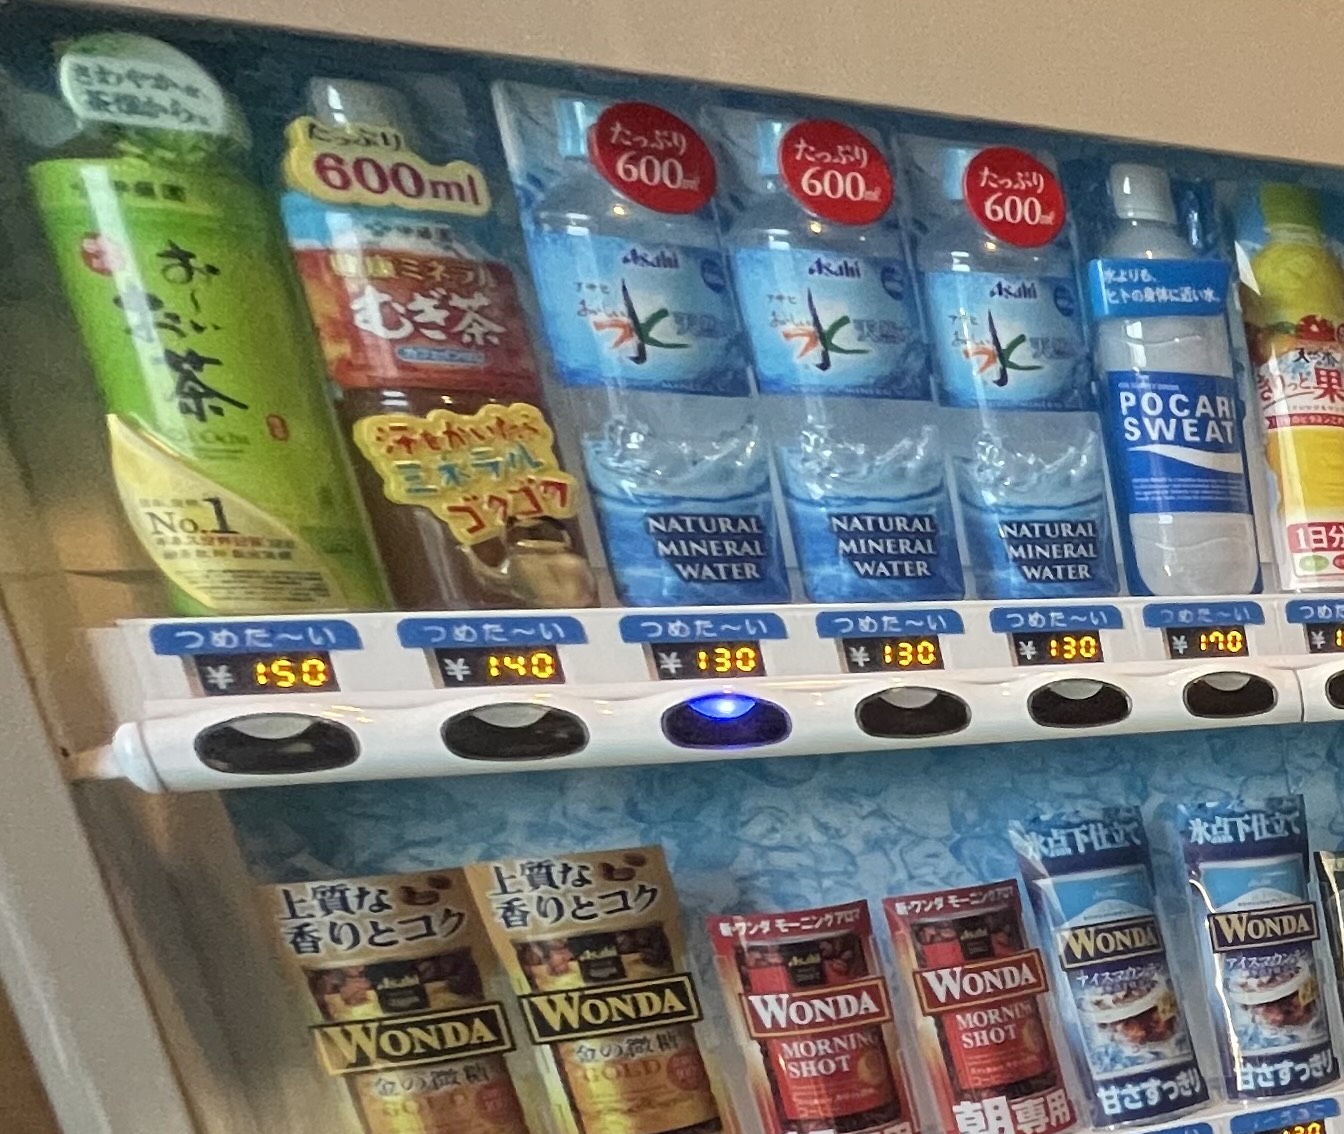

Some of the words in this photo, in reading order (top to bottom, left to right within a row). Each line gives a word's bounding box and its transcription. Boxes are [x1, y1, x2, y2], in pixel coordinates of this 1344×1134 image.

[609, 122, 687, 156] たっぷり
[793, 137, 870, 169] たっぷり
[314, 153, 481, 206] 600ml
[978, 166, 1046, 194] たっぷり
[622, 247, 680, 269] Asahi
[807, 257, 861, 280] Asahi
[989, 279, 1038, 300] Asahi
[350, 284, 508, 346] むぎ茶
[1123, 417, 1234, 444] SWEAT
[447, 476, 570, 535] ゴクゴク
[648, 515, 762, 535] NATURAL
[831, 515, 936, 535] NATURAL
[1003, 521, 1097, 539] NATURAL
[657, 538, 767, 558] MINERAL
[838, 538, 938, 557] MINERAL
[1009, 542, 1099, 561] MINERAL
[674, 562, 762, 582] WATER
[855, 560, 932, 579] WATER
[1022, 564, 1092, 582] WATER
[884, 640, 937, 666] 130
[1050, 636, 1098, 659] 130
[1200, 631, 1243, 653] 170
[256, 658, 329, 688] 150
[489, 652, 555, 679] 140
[698, 647, 757, 672] 130
[1025, 820, 1143, 857] 氷点下仕立て
[1188, 811, 1301, 845] 氷点下仕立て
[491, 860, 591, 896] 上質な
[281, 883, 392, 922] 上質な
[497, 884, 659, 927] 香りとコク
[286, 908, 468, 955] 香りとコク
[1064, 923, 1159, 960] WONDA
[1213, 912, 1311, 943] WONDA
[922, 961, 1037, 1004] WONDA
[535, 987, 688, 1032] WONDA
[748, 991, 882, 1031] WONDA
[326, 1016, 499, 1070] WONDA
[960, 1025, 1018, 1049] SHOT
[786, 1055, 853, 1079] SHOT
[1239, 1053, 1335, 1091] 甘さすっきり
[1096, 1066, 1200, 1117] 甘さすっきり
